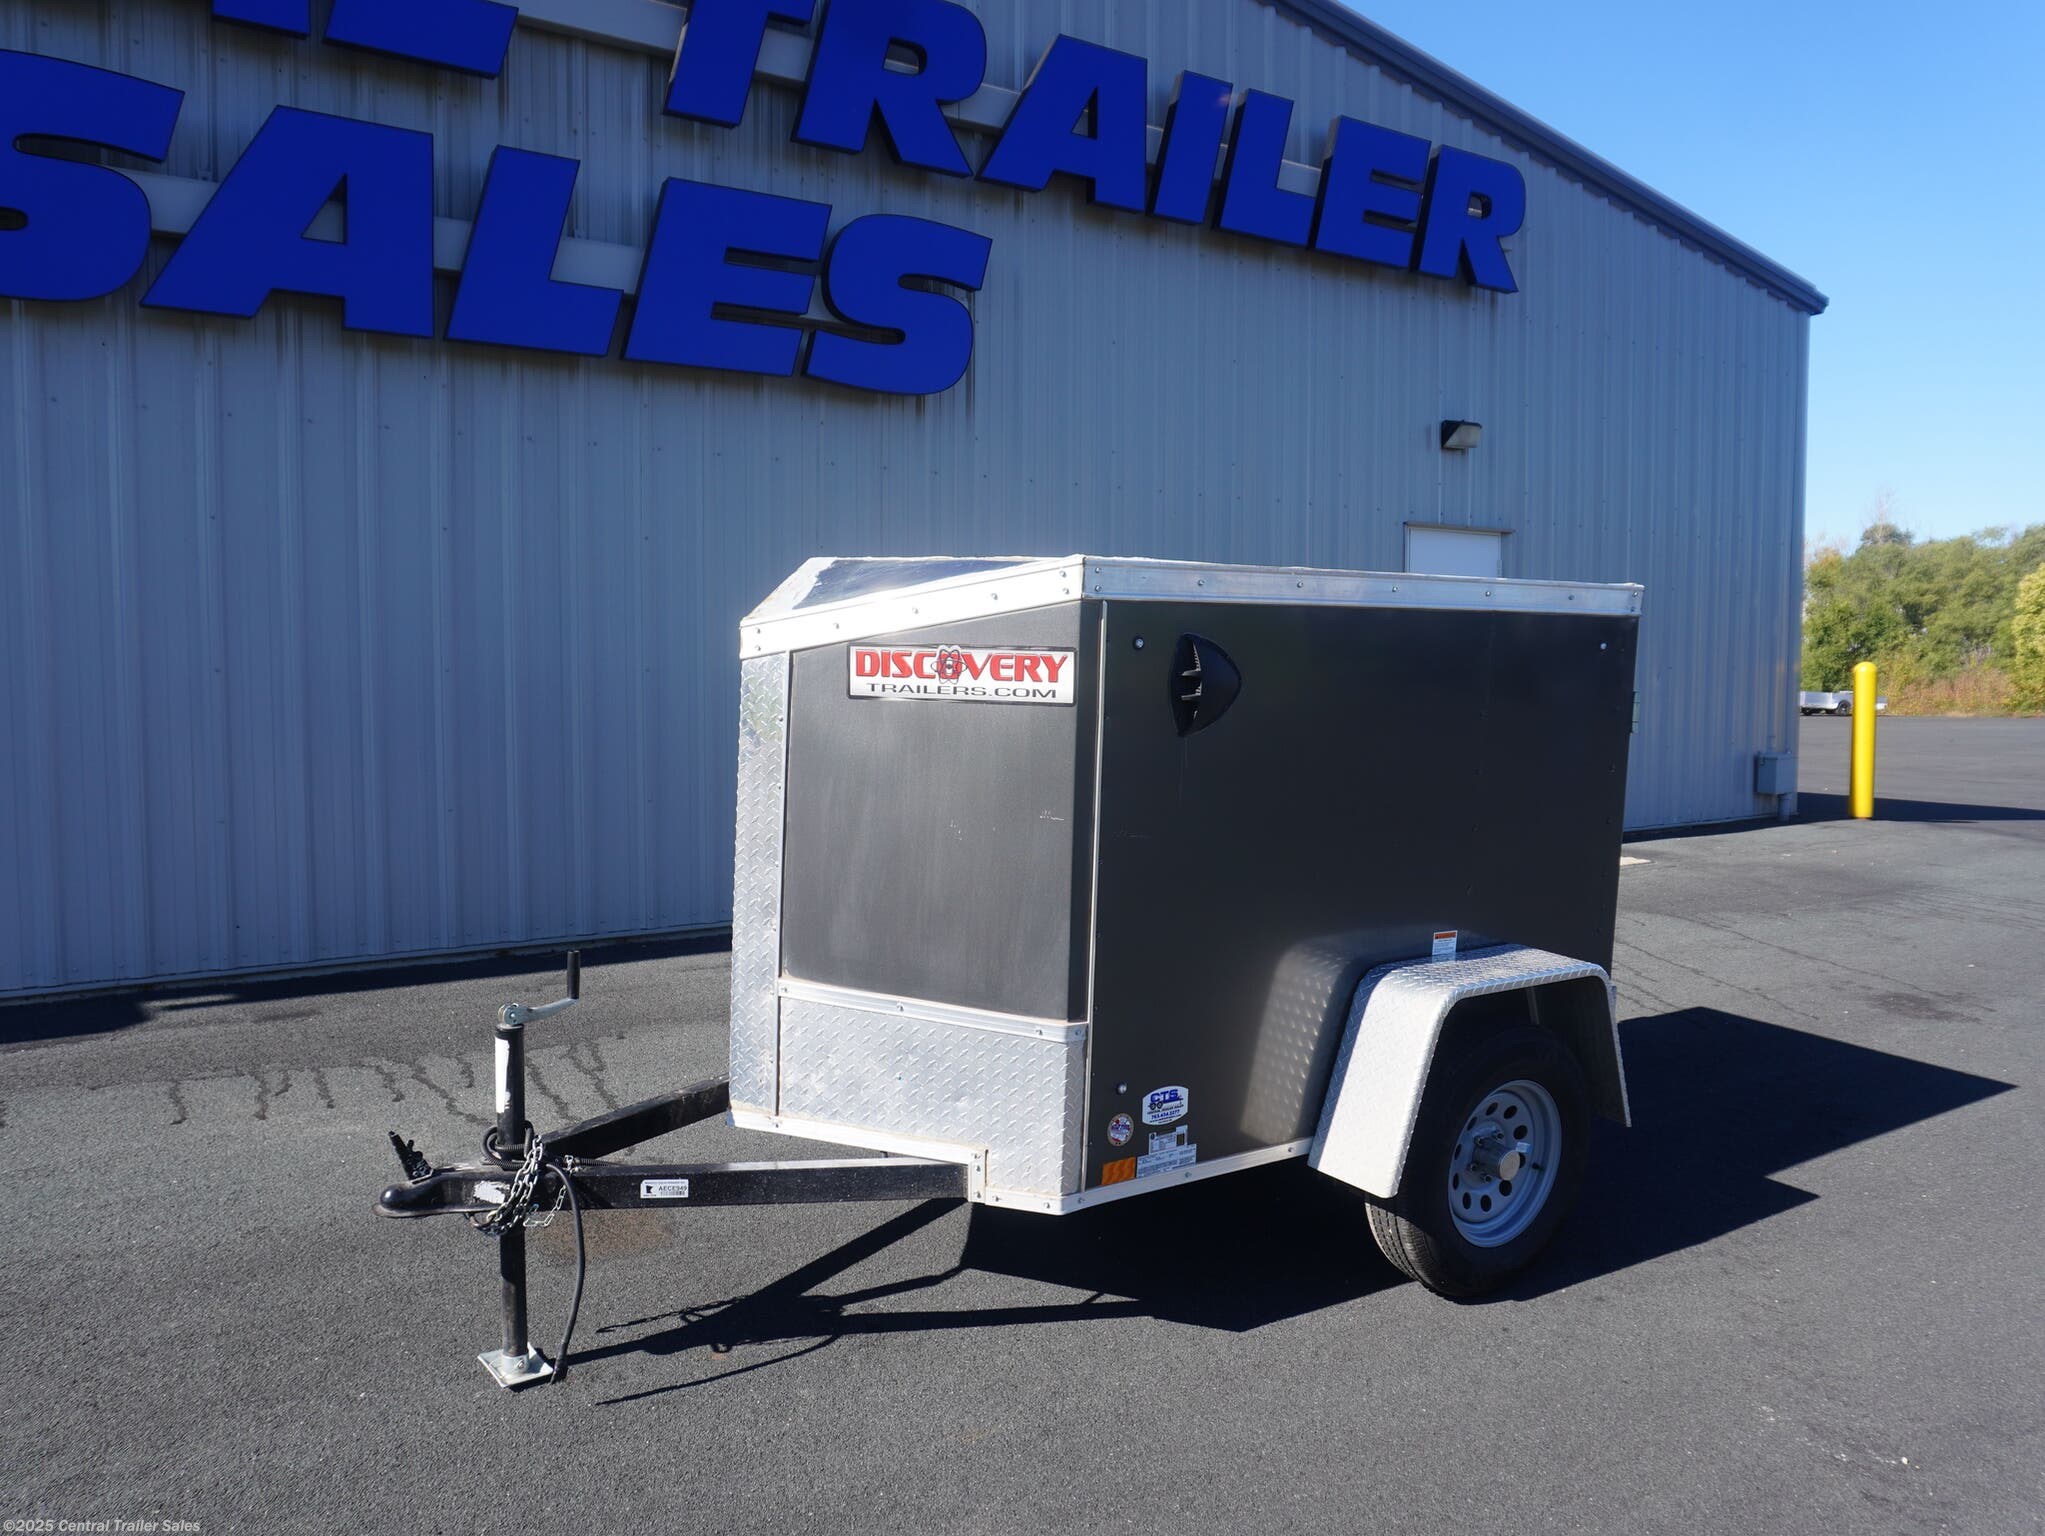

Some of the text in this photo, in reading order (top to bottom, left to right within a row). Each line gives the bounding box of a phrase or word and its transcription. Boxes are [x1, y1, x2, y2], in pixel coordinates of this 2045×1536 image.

[662, 0, 1526, 294] TRAILER
[0, 50, 992, 396] SALES
[855, 649, 1068, 683] DISCOVERY
[867, 682, 1057, 698] TRAILERS.COM
[1150, 1088, 1179, 1103] CTS
